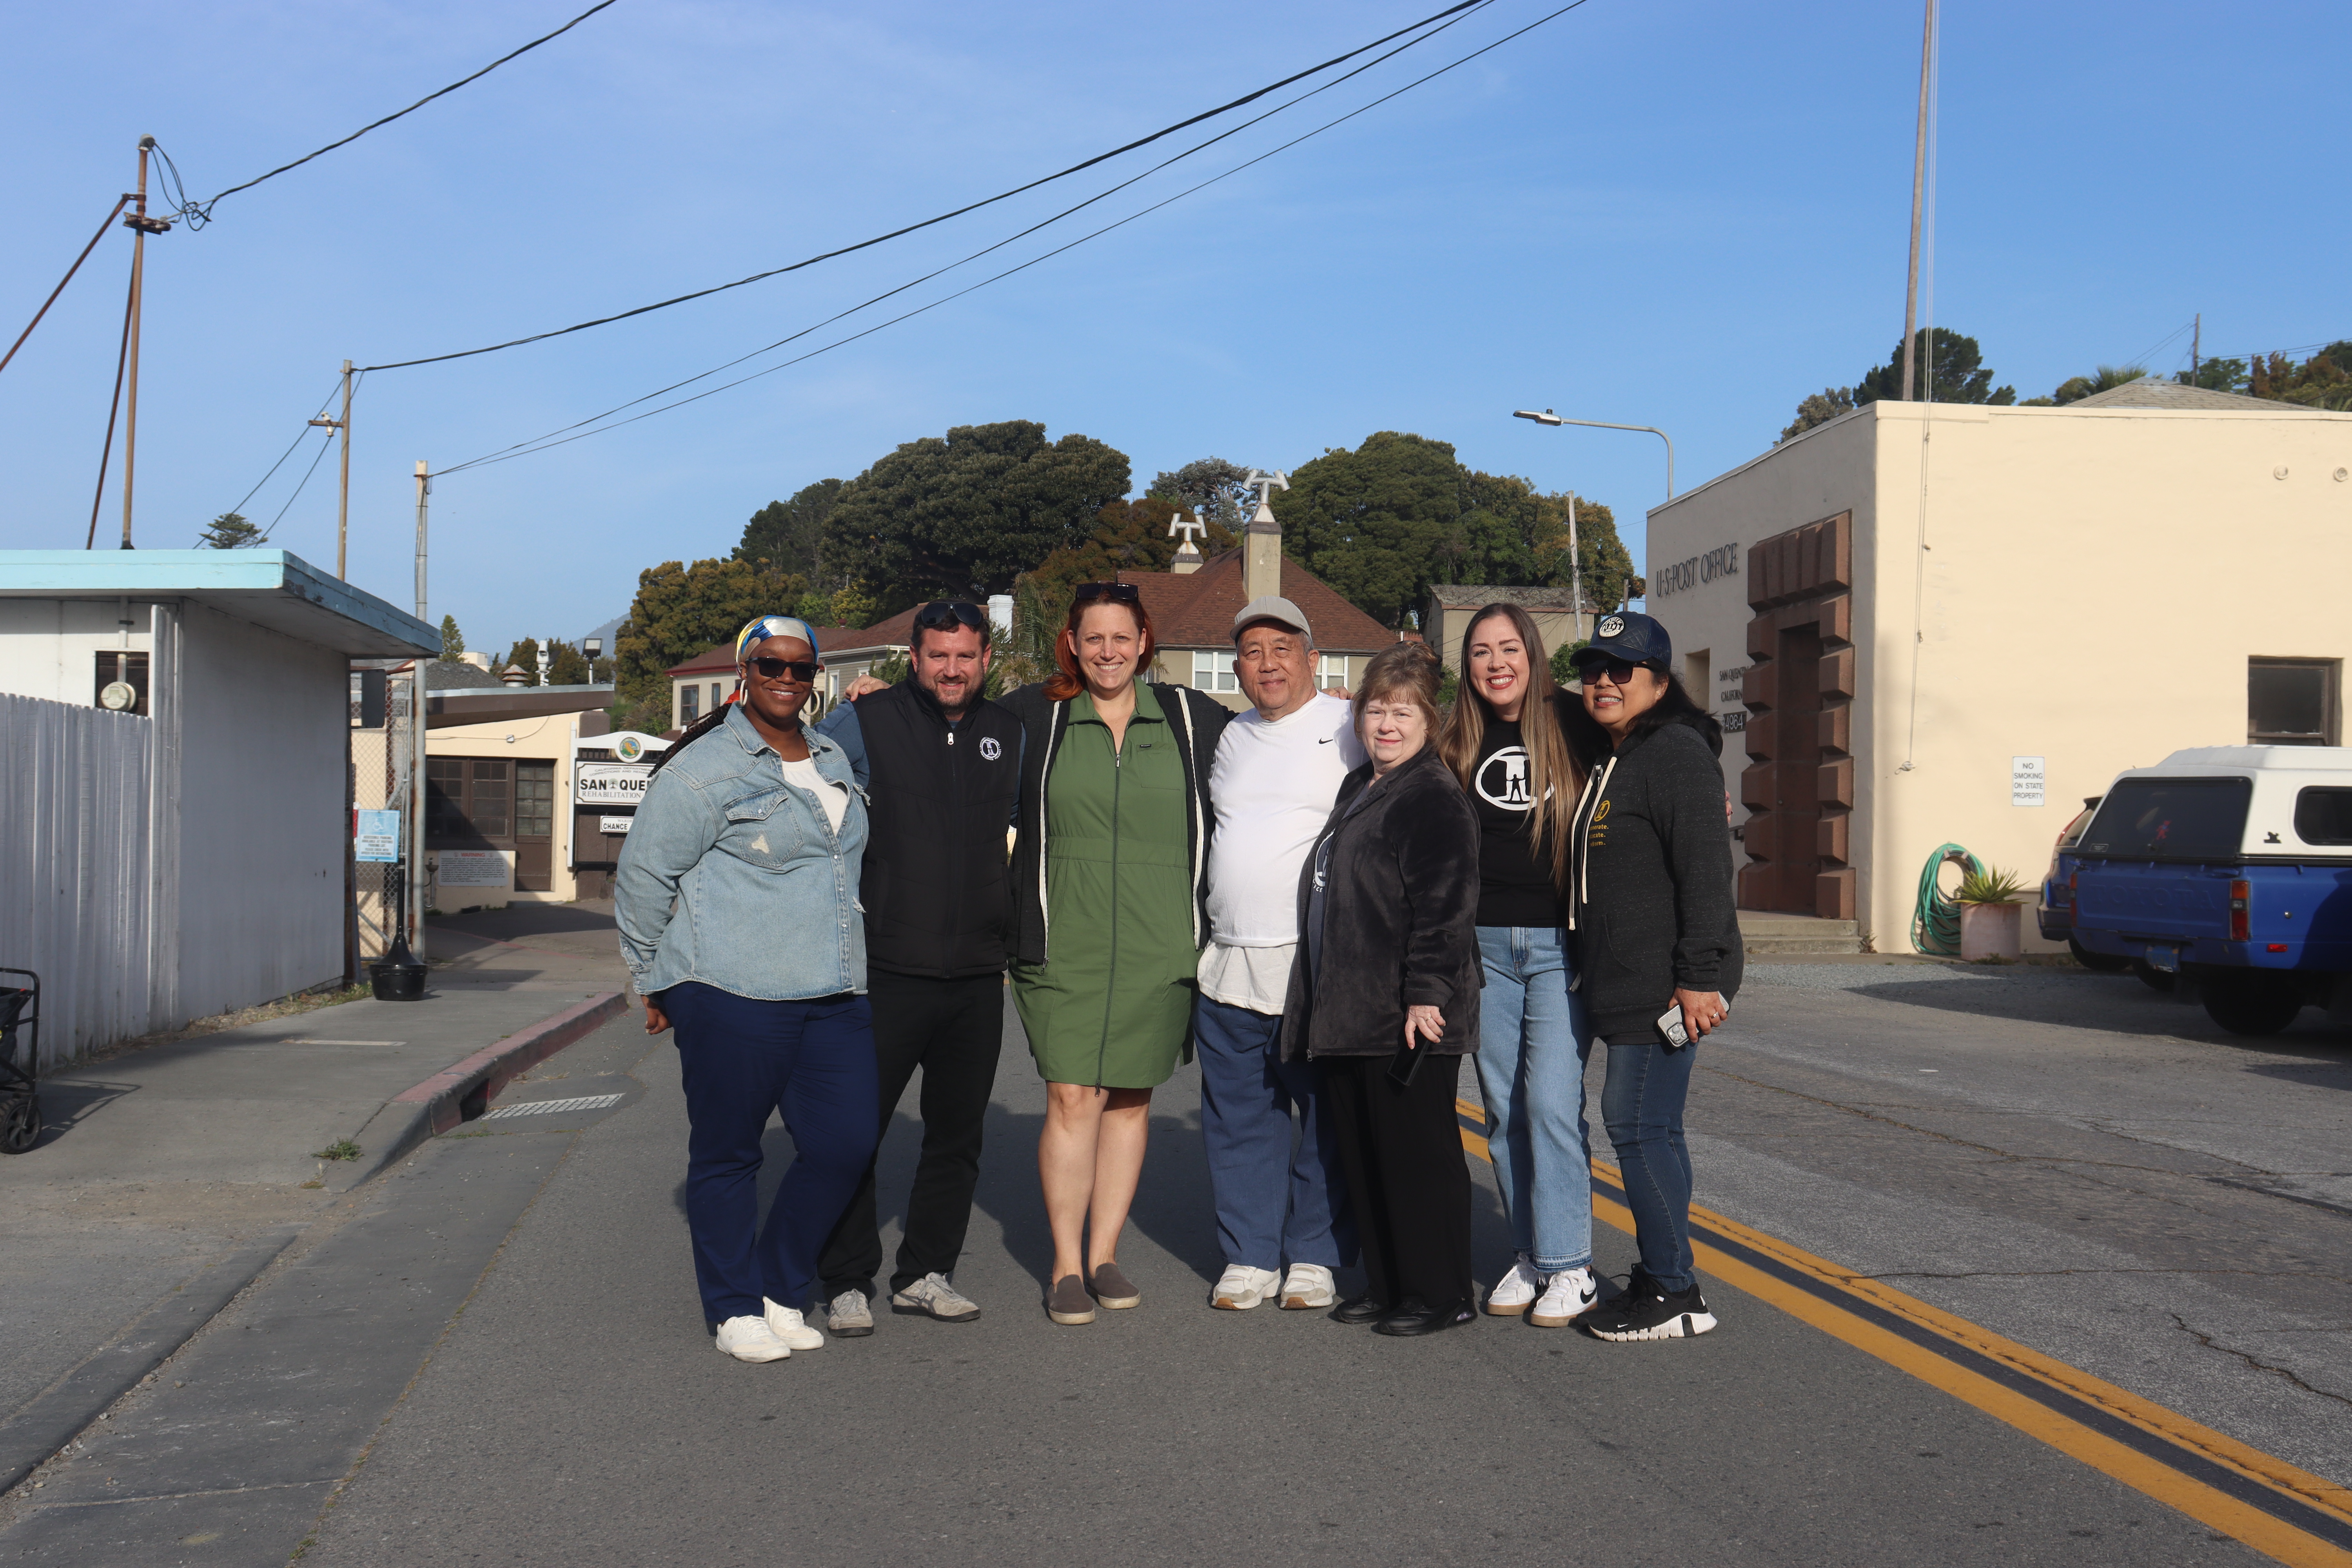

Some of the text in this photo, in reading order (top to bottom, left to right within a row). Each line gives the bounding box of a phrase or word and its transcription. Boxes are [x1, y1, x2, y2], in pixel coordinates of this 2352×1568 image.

[1700, 542, 1738, 583] OFFICE
[580, 779, 650, 791] SAN QUE
[2089, 884, 2216, 909] TOYOTA
